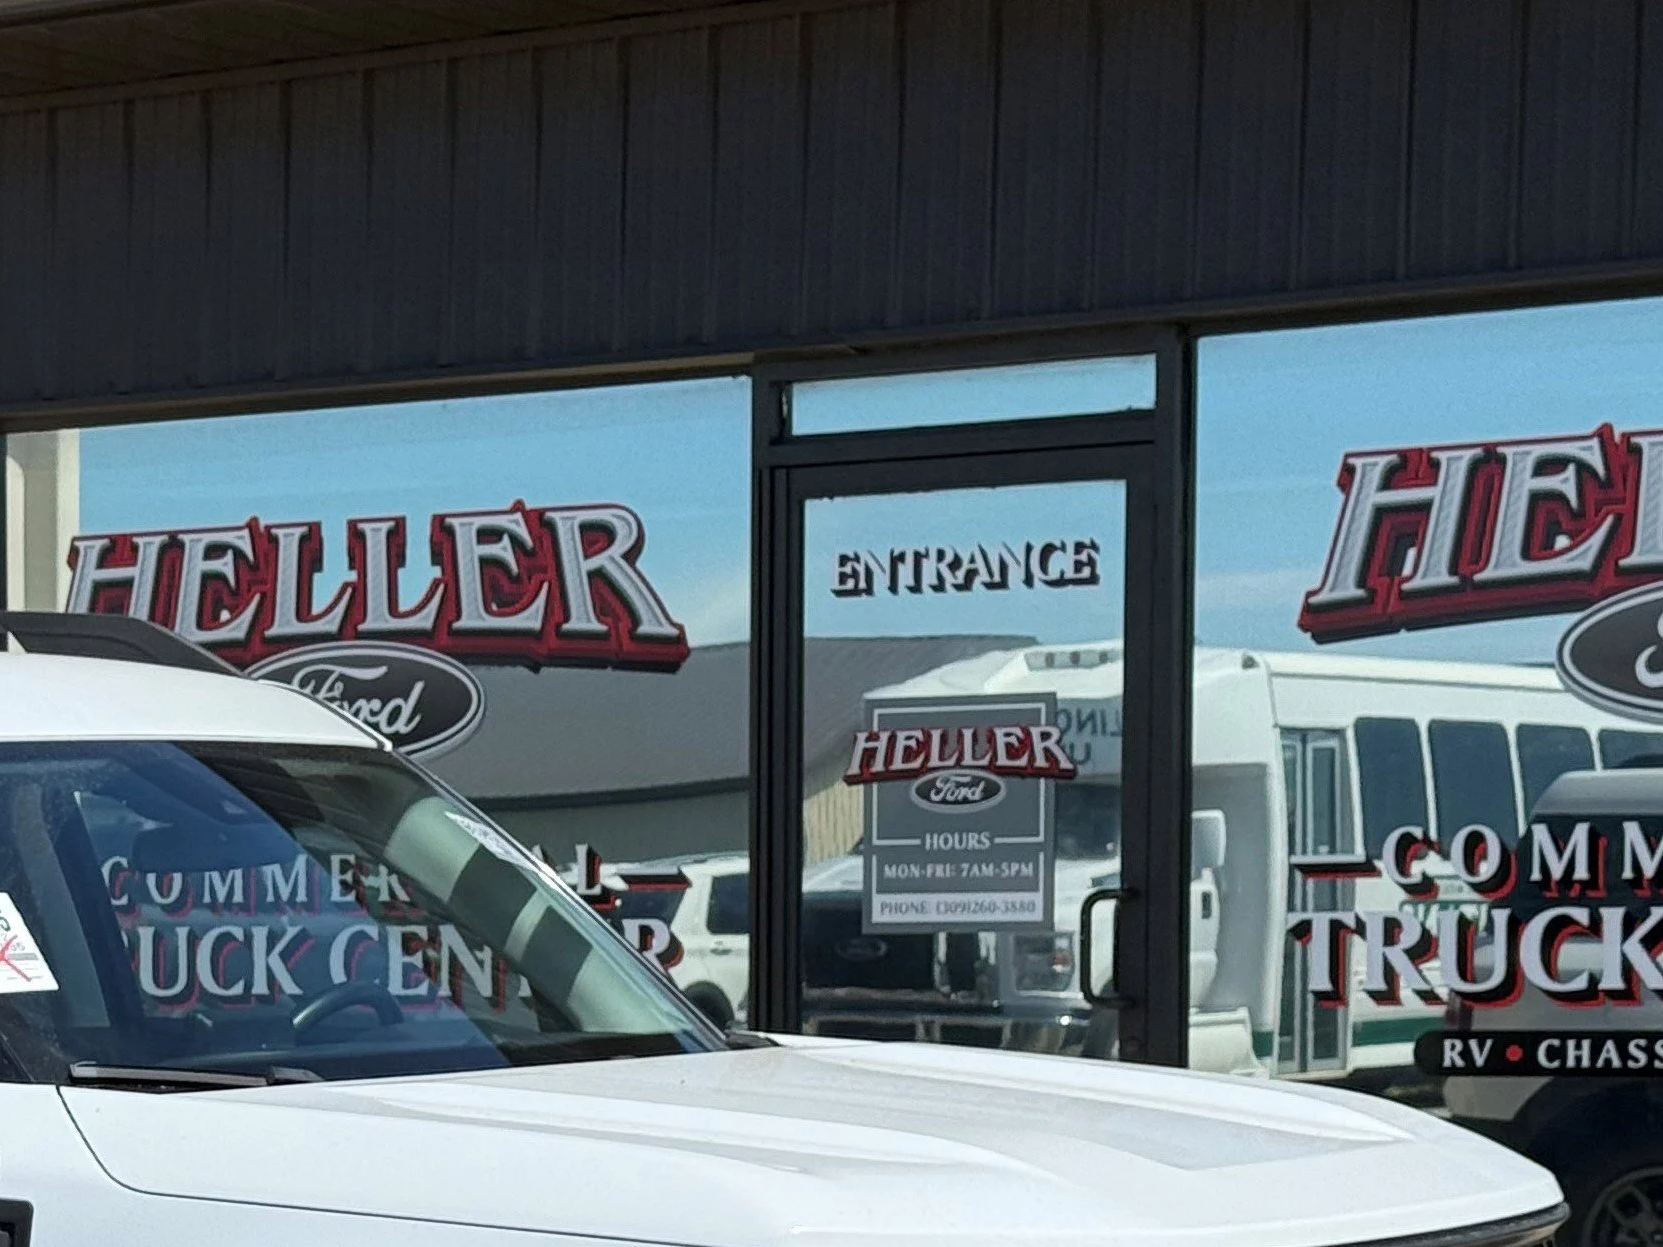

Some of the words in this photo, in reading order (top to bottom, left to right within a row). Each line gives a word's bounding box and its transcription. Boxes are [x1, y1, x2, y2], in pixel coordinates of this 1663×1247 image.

[67, 503, 687, 655] HELLER
[831, 536, 1101, 597] ENTRANCE
[844, 725, 1077, 781] HELLER
[930, 774, 986, 802] Ford
[925, 831, 992, 851] HOURS
[1288, 905, 1663, 995] TRUCK
[1442, 1038, 1494, 1069] RV
